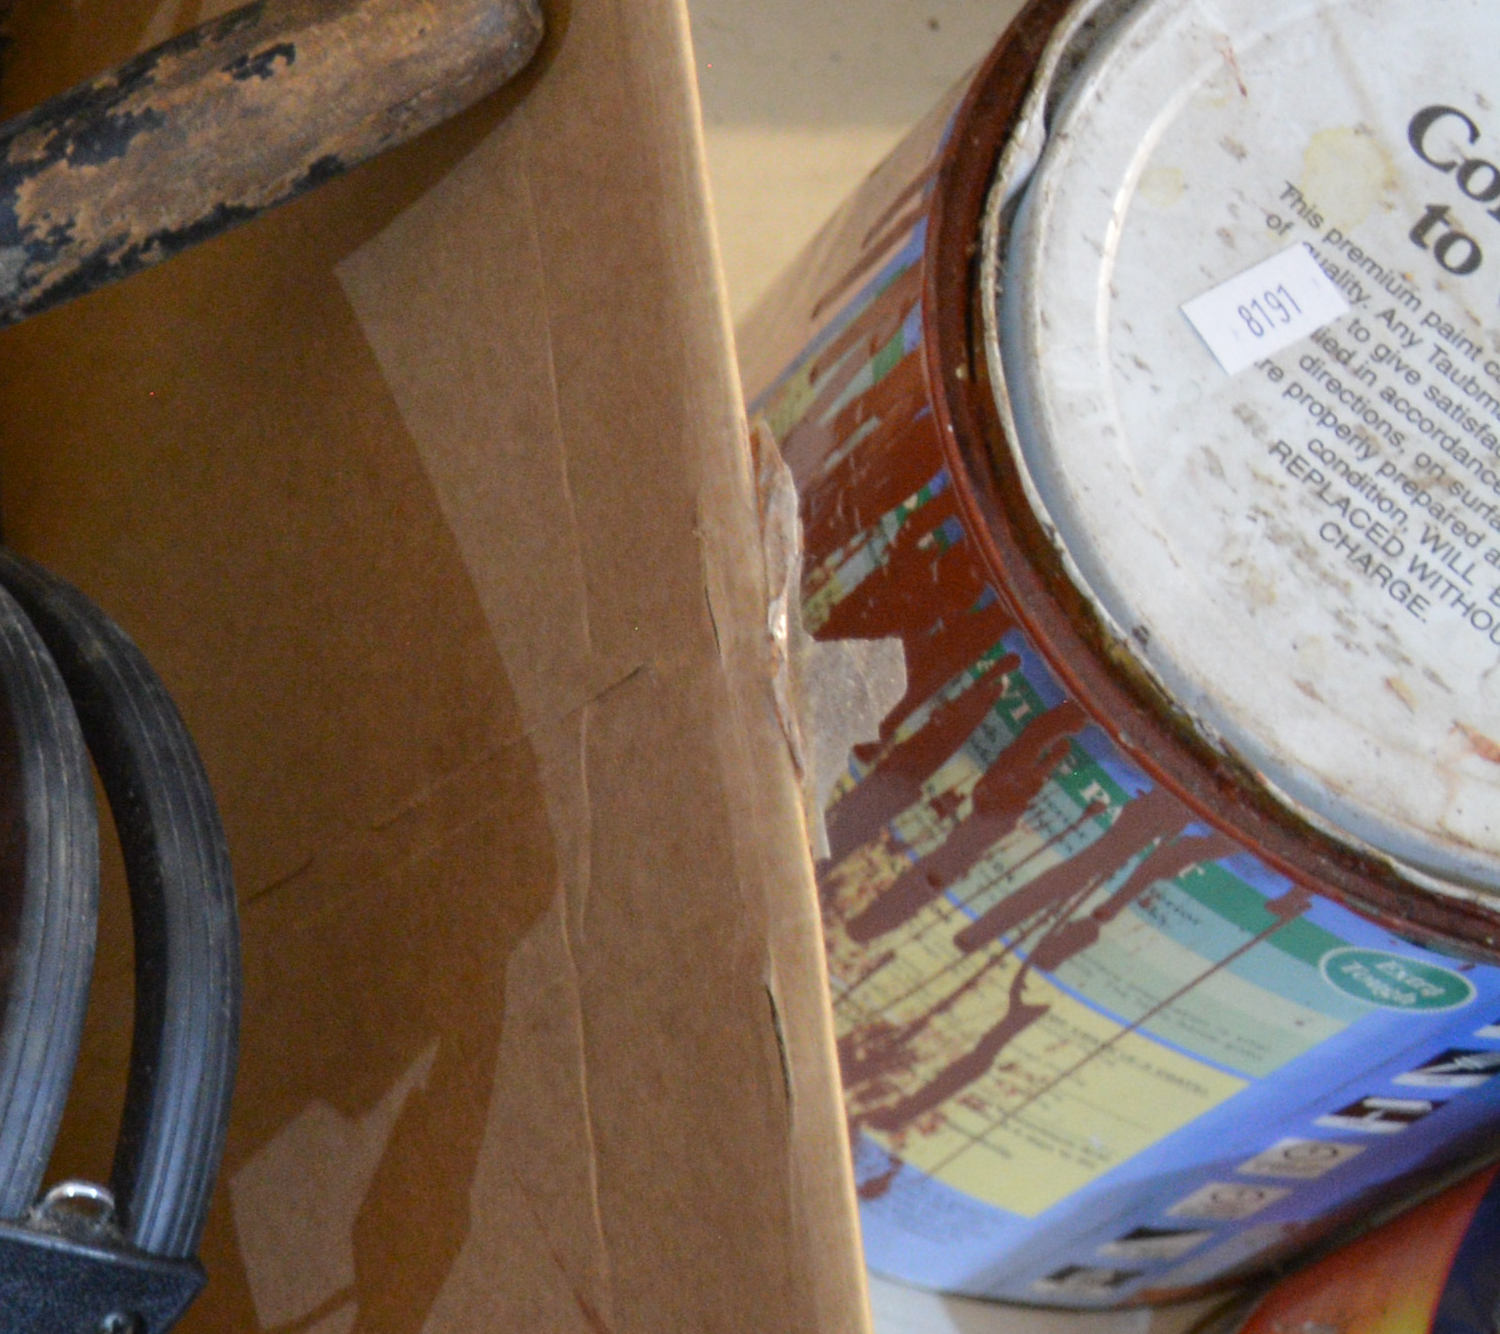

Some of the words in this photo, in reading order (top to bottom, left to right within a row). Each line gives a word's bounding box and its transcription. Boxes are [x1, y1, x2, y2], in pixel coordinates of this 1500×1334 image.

[1266, 210, 1295, 238] of
[1376, 307, 1423, 350] Any
[1280, 180, 1325, 229] This
[1323, 228, 1432, 314] premium
[1420, 309, 1484, 362] paint
[1409, 202, 1484, 277] to
[1236, 284, 1303, 339] 8191
[1347, 318, 1371, 343] to
[1369, 342, 1422, 386] give
[1268, 440, 1405, 559] REPLACED
[1282, 381, 1380, 463] properly
[1375, 460, 1487, 550] prepared
[1413, 450, 1446, 477] on
[1318, 521, 1432, 624] CHARGE.
[1419, 522, 1477, 587] WILL
